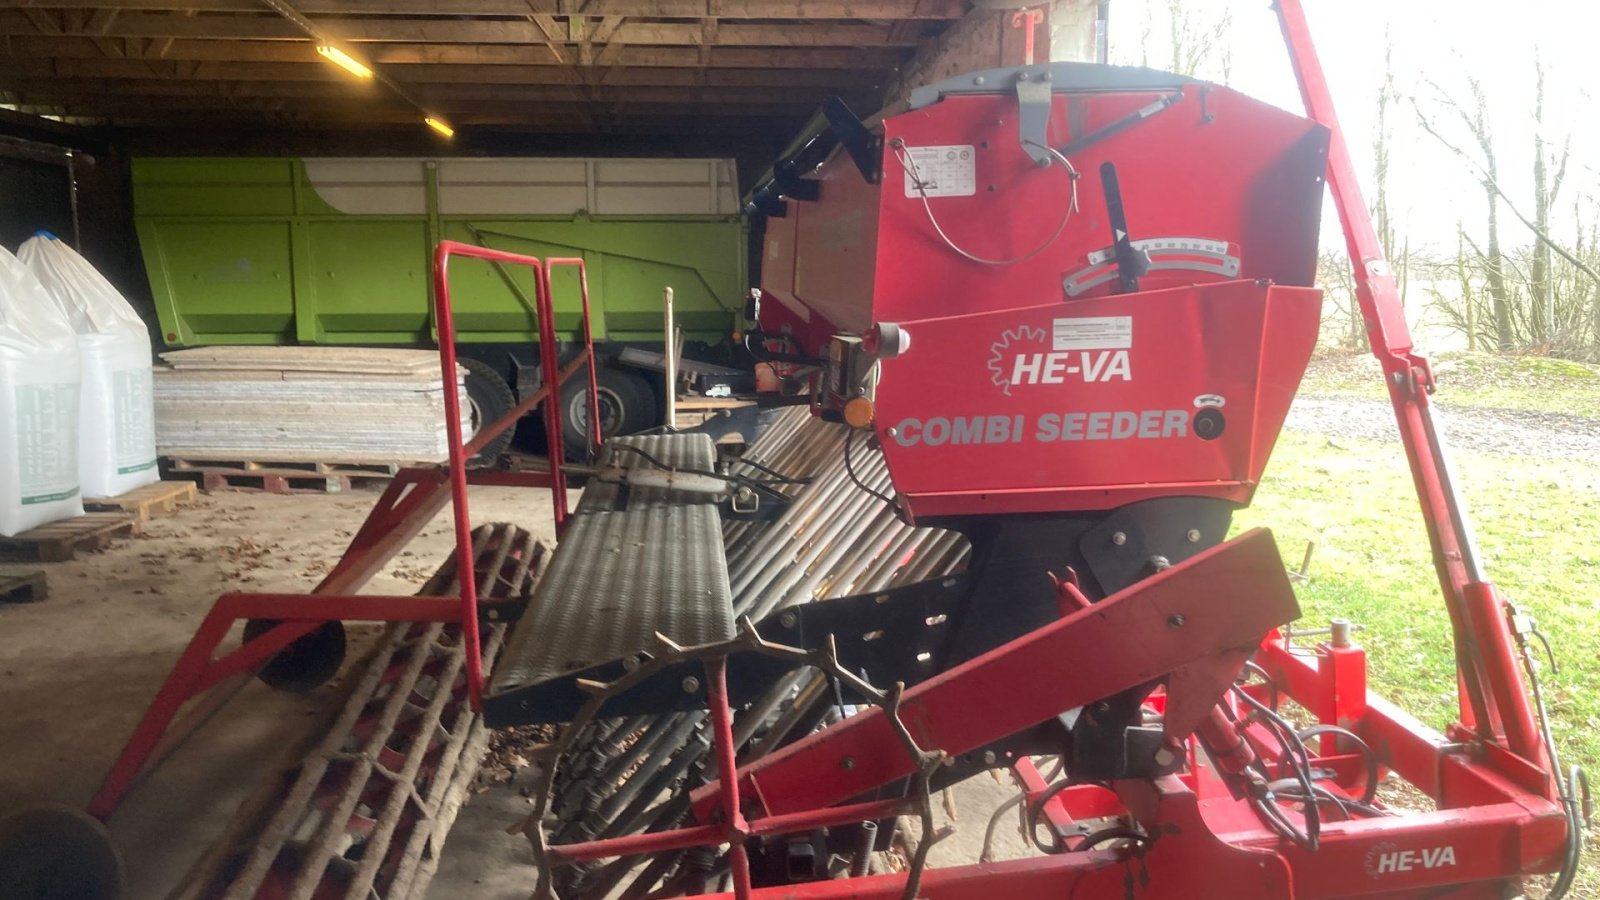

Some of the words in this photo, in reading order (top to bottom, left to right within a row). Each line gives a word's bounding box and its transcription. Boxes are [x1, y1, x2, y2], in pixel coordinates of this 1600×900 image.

[1011, 350, 1132, 385] HE-VA
[894, 414, 1025, 446] COMBI
[1035, 409, 1189, 442] SEEDER
[1378, 846, 1456, 873] HE-VA
